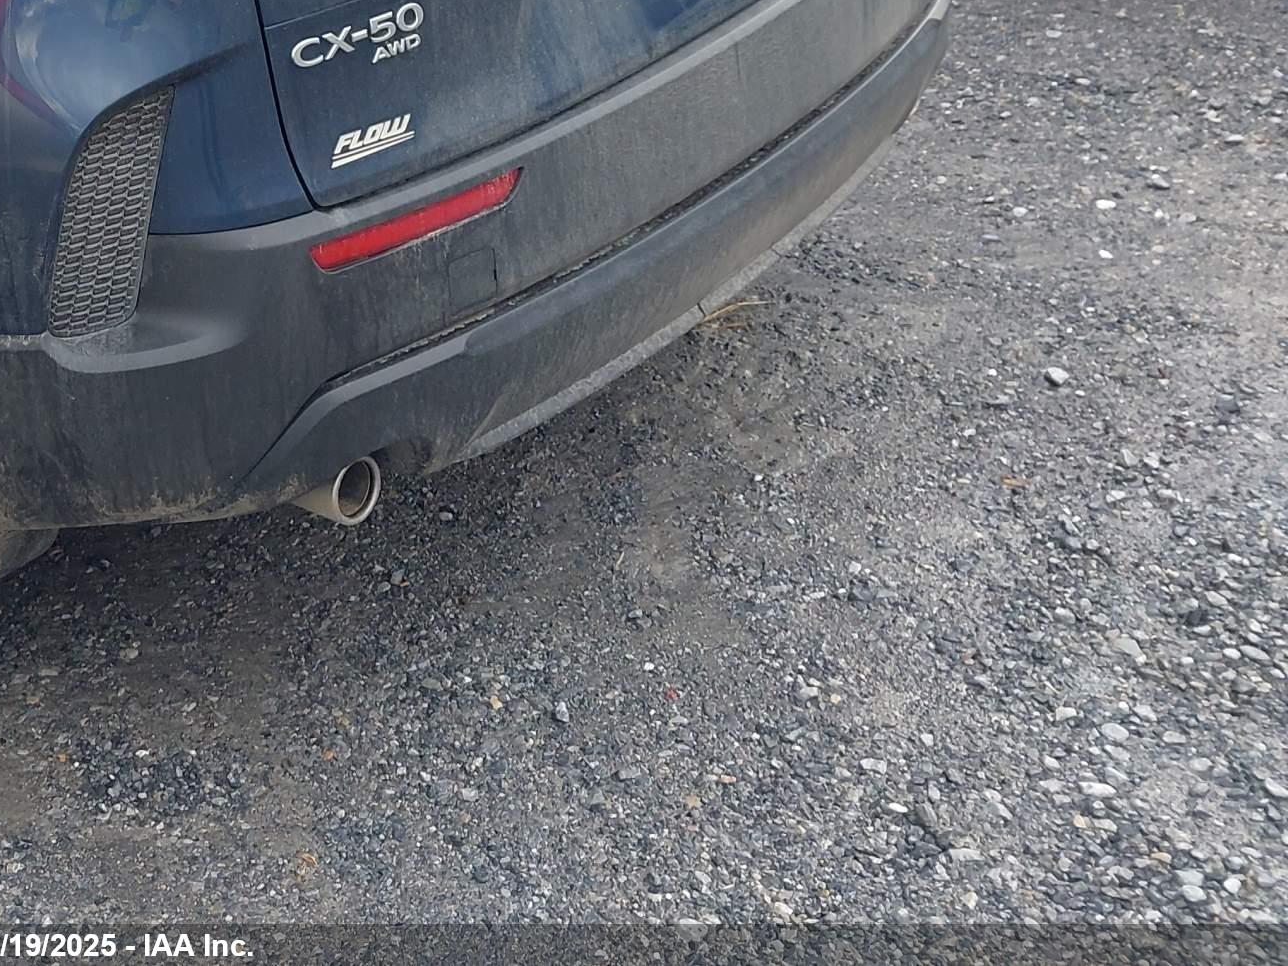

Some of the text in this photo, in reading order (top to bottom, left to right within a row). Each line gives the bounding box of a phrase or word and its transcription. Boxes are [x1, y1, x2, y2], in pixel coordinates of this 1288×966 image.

[291, 2, 424, 68] CX-50
[371, 34, 422, 64] AWD
[333, 113, 412, 155] FLOW
